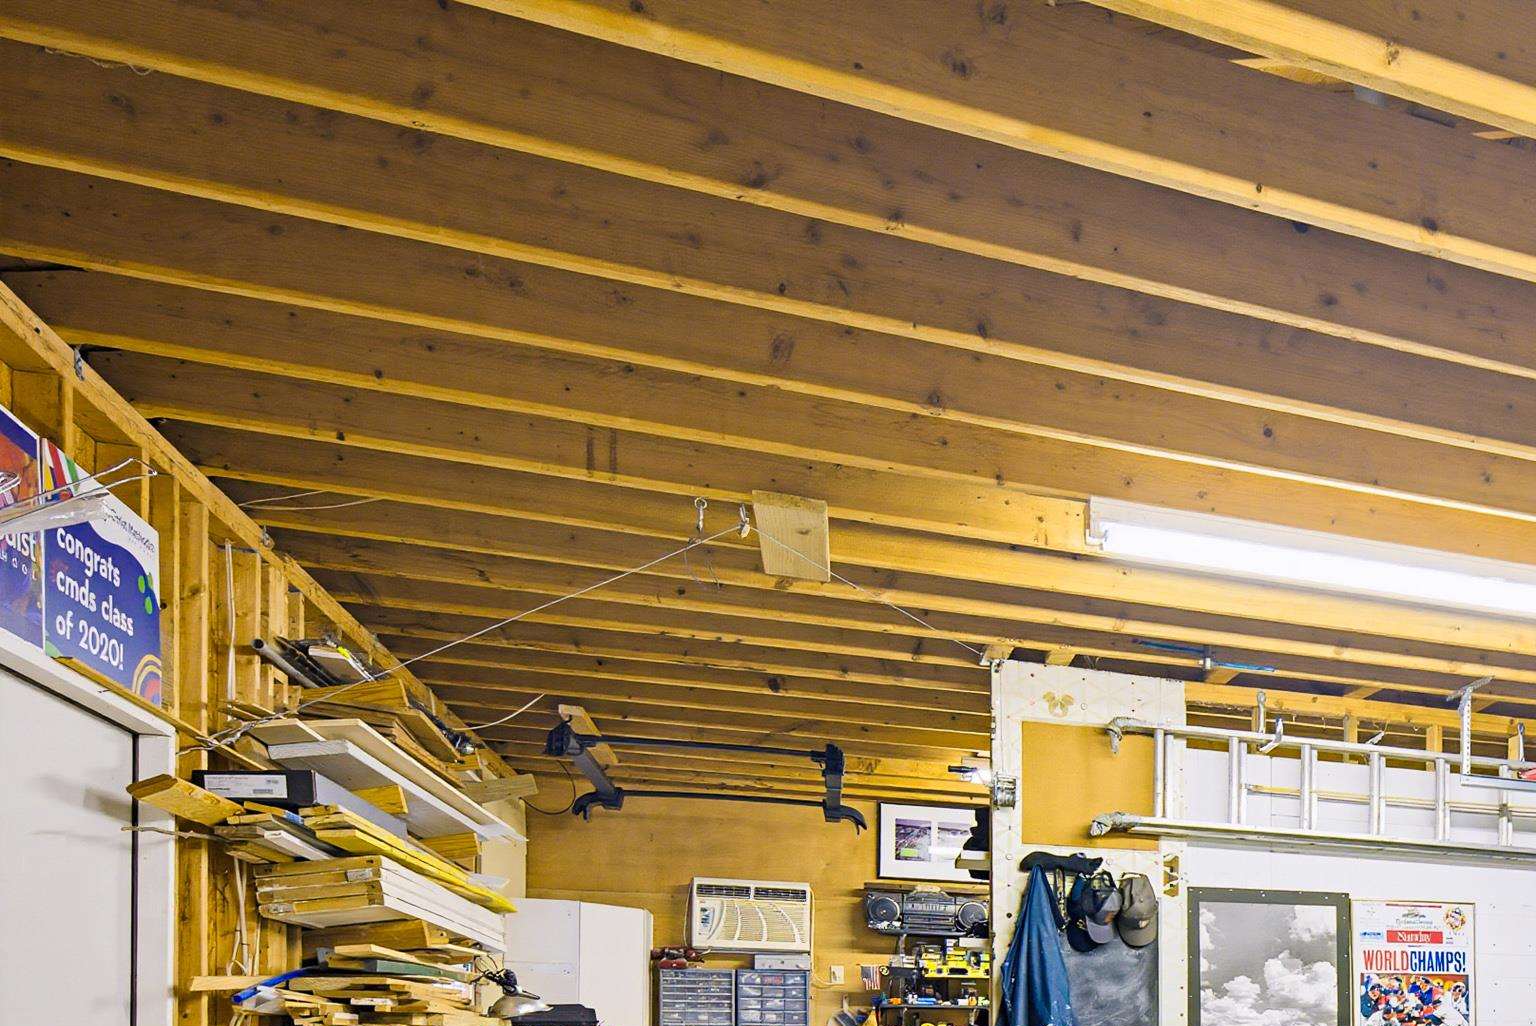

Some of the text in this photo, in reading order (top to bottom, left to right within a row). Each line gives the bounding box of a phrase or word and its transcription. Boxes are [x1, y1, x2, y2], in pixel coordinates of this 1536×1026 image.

[56, 527, 121, 588] congrats
[56, 569, 134, 637] cmds class
[56, 611, 125, 672] of 2020!
